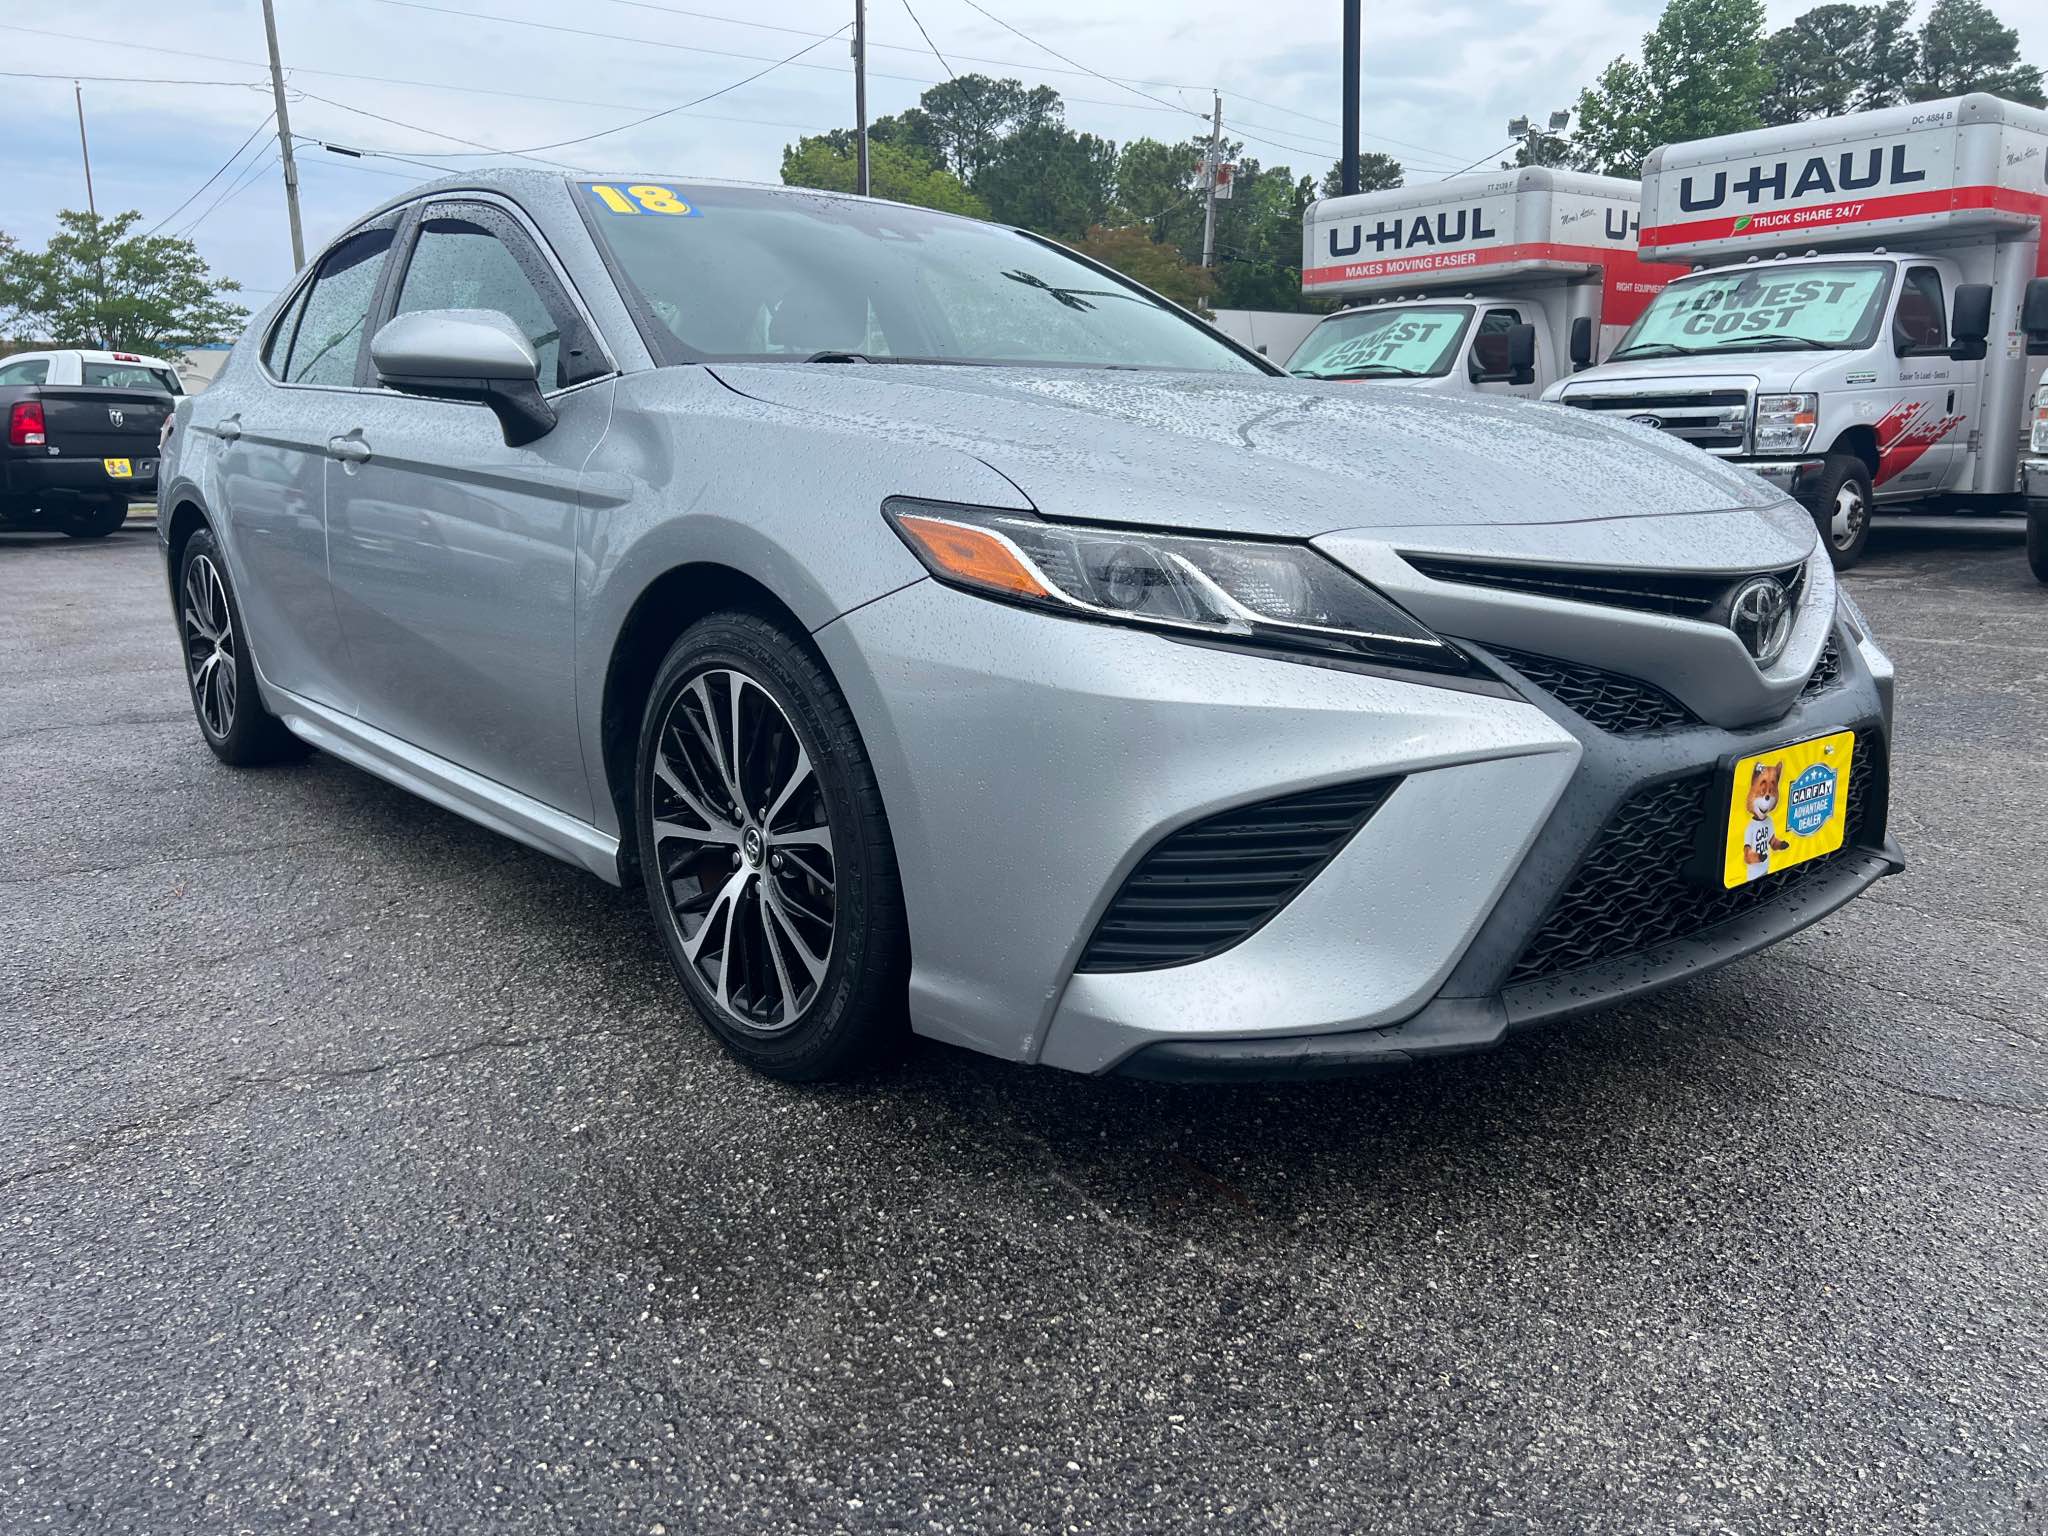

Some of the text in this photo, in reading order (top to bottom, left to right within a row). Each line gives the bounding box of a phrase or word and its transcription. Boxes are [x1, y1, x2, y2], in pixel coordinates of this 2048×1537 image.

[1912, 115, 1925, 125] DC
[591, 185, 692, 215] 18
[1753, 204, 1863, 228] TRUCK SHARE 24/7
[1345, 253, 1476, 278] MAKES MOVING EASIER
[1616, 282, 1633, 293] RIGHT
[1669, 280, 1857, 320] LOWEST
[1683, 304, 1806, 336] COST
[1792, 780, 1832, 804] CARFAX
[1794, 799, 1828, 819] ADVANTAGE
[1799, 813, 1821, 830] DEALER
[1756, 826, 1769, 842] CAR
[1756, 840, 1769, 854] FOX
